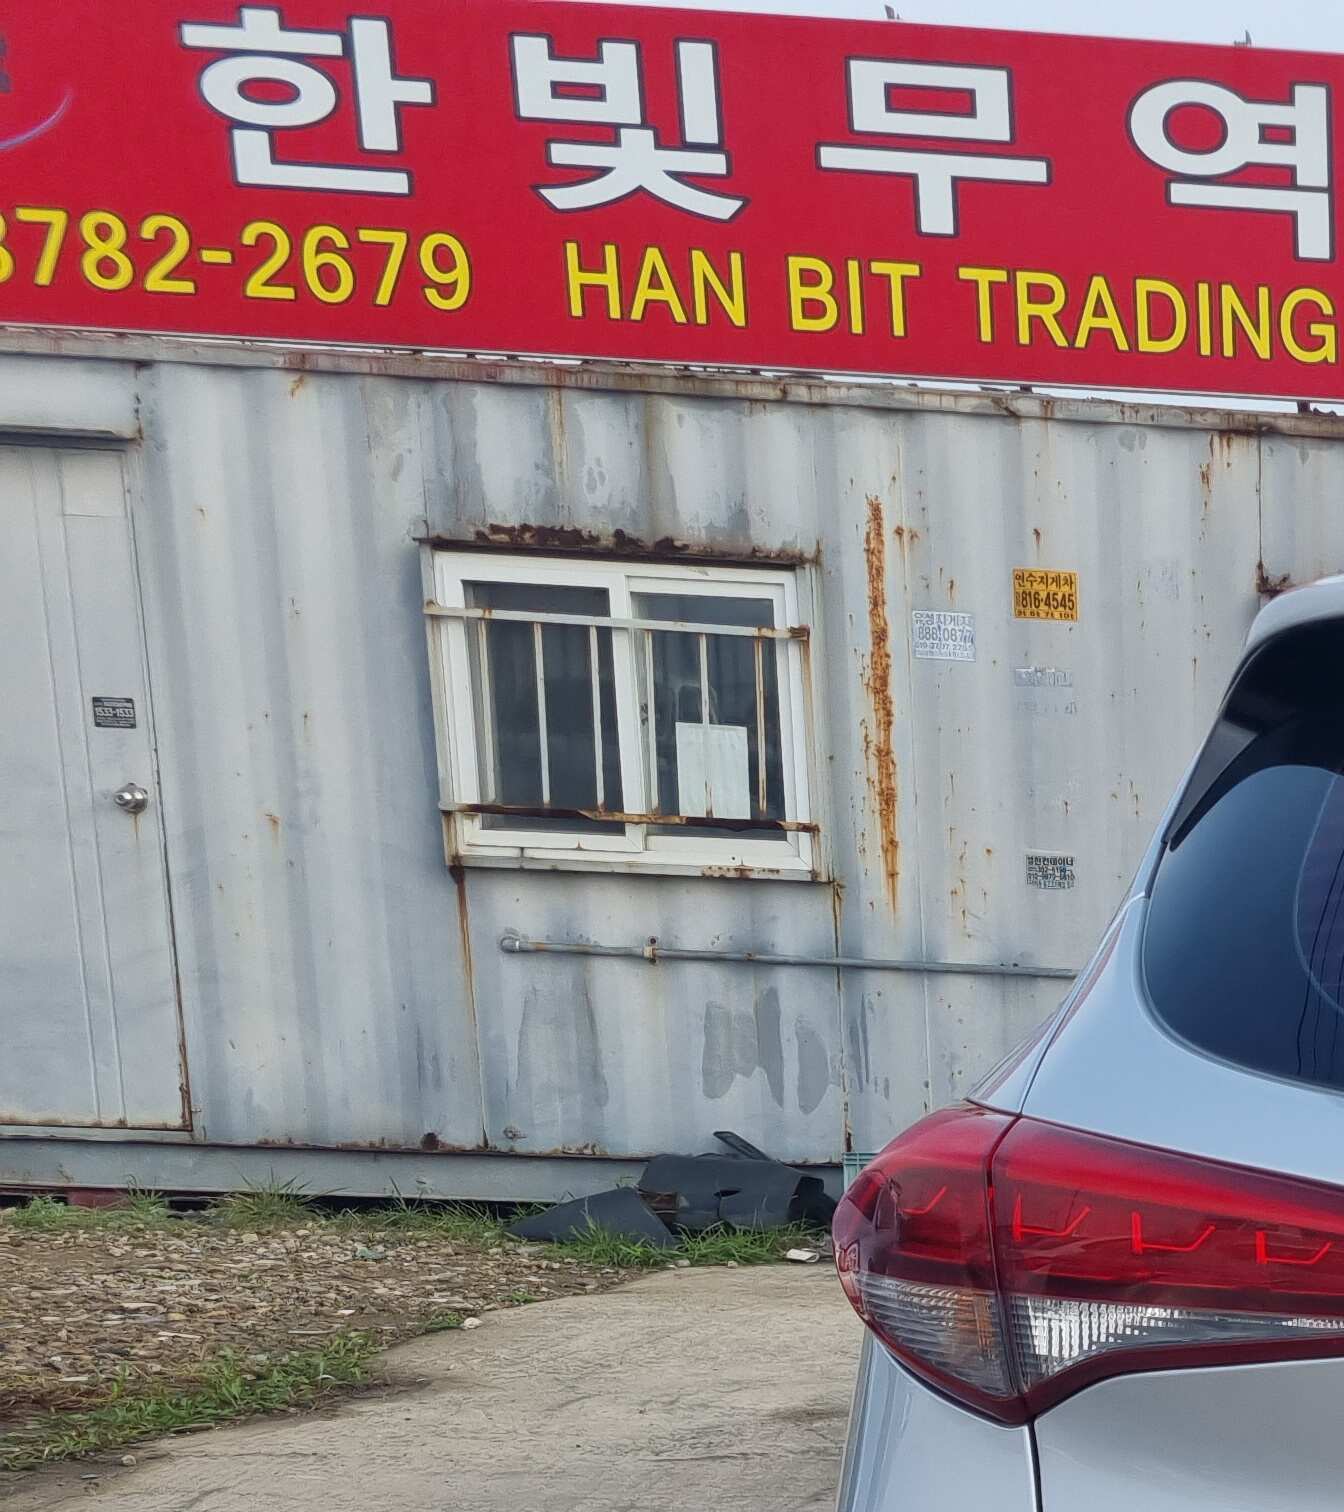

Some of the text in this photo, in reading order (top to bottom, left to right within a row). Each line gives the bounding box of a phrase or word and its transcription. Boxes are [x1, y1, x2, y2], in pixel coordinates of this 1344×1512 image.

[0, 206, 471, 311] 782-2679
[564, 241, 1337, 364] HAN BIT TRADING
